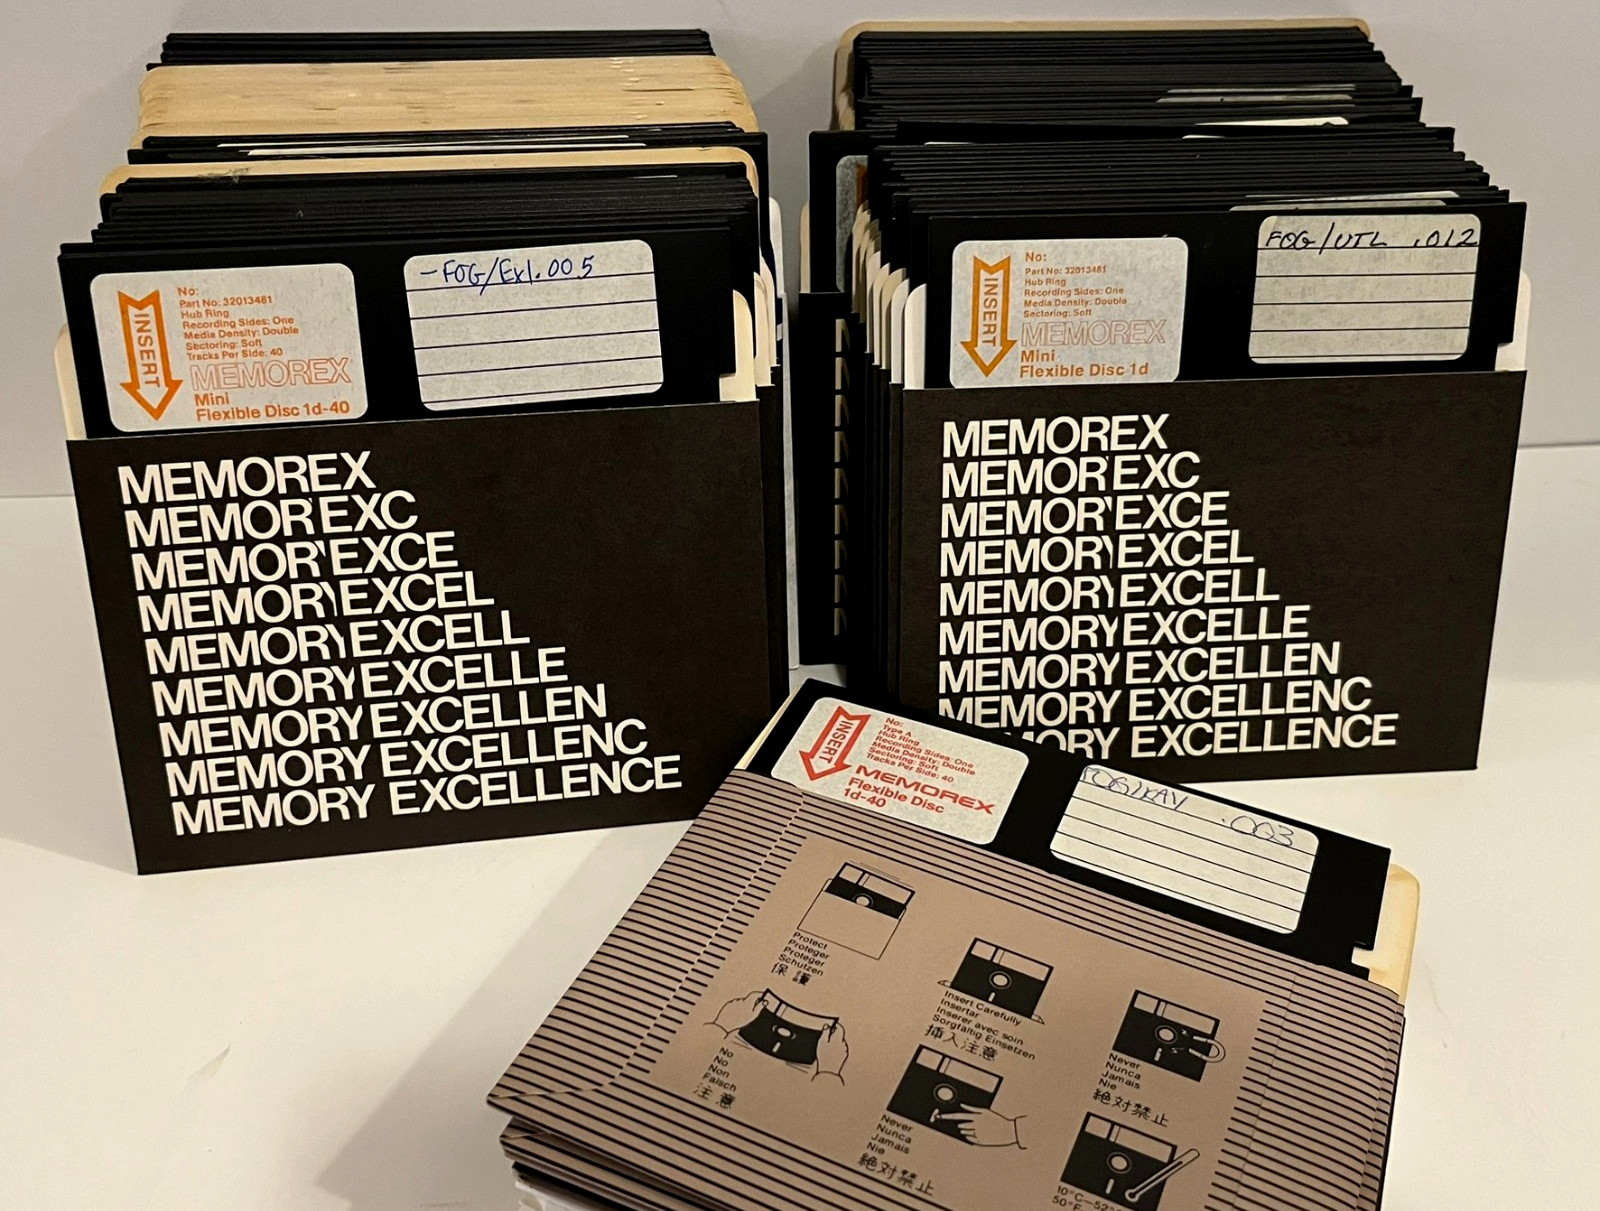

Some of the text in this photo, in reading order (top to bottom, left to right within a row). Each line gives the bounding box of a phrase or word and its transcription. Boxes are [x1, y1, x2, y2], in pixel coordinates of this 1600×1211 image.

[1266, 222, 1387, 255] FOG/UTL
[1025, 252, 1046, 262] No:
[178, 287, 198, 296] No:
[1046, 278, 1066, 287] Ring
[1024, 289, 1071, 297] Recording
[1054, 299, 1092, 307] Density:
[180, 300, 199, 308] Part
[205, 309, 229, 318] Ring
[983, 277, 999, 346] INSERT
[1024, 310, 1071, 318] Sectoring:
[183, 320, 236, 329] Recording
[239, 318, 270, 327] Sides:
[184, 327, 299, 339] Media Density: Double
[1021, 319, 1167, 346] MEMOREX
[135, 313, 161, 389] INSERT
[186, 339, 262, 351] Sectoring: Soft
[187, 352, 219, 361] Tracks
[222, 351, 238, 359] Per
[270, 348, 282, 356] 40
[1021, 350, 1055, 363] Mini
[191, 357, 351, 391] MEMOREX
[1020, 362, 1148, 378] Flexible Disc 1d
[195, 393, 229, 406] Mini
[196, 401, 349, 421] Flexible Disc 1d-40
[943, 413, 1169, 458] MEMOREX
[118, 451, 376, 505] MEMOREX
[1120, 568, 1280, 608] EXCELL
[350, 611, 530, 658] EXCELL
[939, 605, 1310, 656] MEMORY EXCELLE
[939, 642, 1341, 694] MEMORY EXCELLEN
[152, 647, 568, 717] MEMORY EXCELLE
[939, 677, 1372, 728] MEMORY EXCELLENC
[159, 684, 607, 758] MEMORY EXCELLEN
[882, 725, 903, 735] Type
[885, 717, 903, 727] No:
[819, 720, 854, 764] INSERT
[879, 730, 920, 746] Hub Ring
[1131, 713, 1399, 758] EXCELLENCE
[165, 719, 648, 797] MEMORY EXCELLENC
[869, 747, 939, 771] Sectoring: Soft
[872, 742, 975, 775] Media Density: Double
[875, 736, 974, 768] Recording Sides: One
[866, 753, 954, 783] Tracks Per Side: 40
[171, 755, 682, 836] MEMORY EXCELLENCE
[844, 788, 886, 807] 1d-40
[848, 777, 944, 813] Flexible Disc
[856, 765, 996, 814] MEMOREX
[788, 939, 829, 959] Proteger
[793, 932, 827, 950] Protect
[940, 998, 980, 1018] Insertar
[944, 990, 1022, 1027] Insert Carefully
[975, 1023, 999, 1036] avec
[1002, 1033, 1024, 1045] soin
[719, 1047, 733, 1058] No
[985, 1036, 1036, 1060] Einsetzen
[713, 1055, 728, 1066] No
[1108, 1053, 1141, 1069] Never
[708, 1064, 730, 1078] Non
[1102, 1071, 1140, 1089] Jamais
[1106, 1062, 1141, 1080] Nunca
[702, 1072, 737, 1091] Falsch
[1099, 1079, 1117, 1090] Nie
[881, 1114, 913, 1132] Never
[871, 1133, 910, 1154] Jamais
[876, 1124, 912, 1144] Nunca
[867, 1142, 885, 1155] Nie
